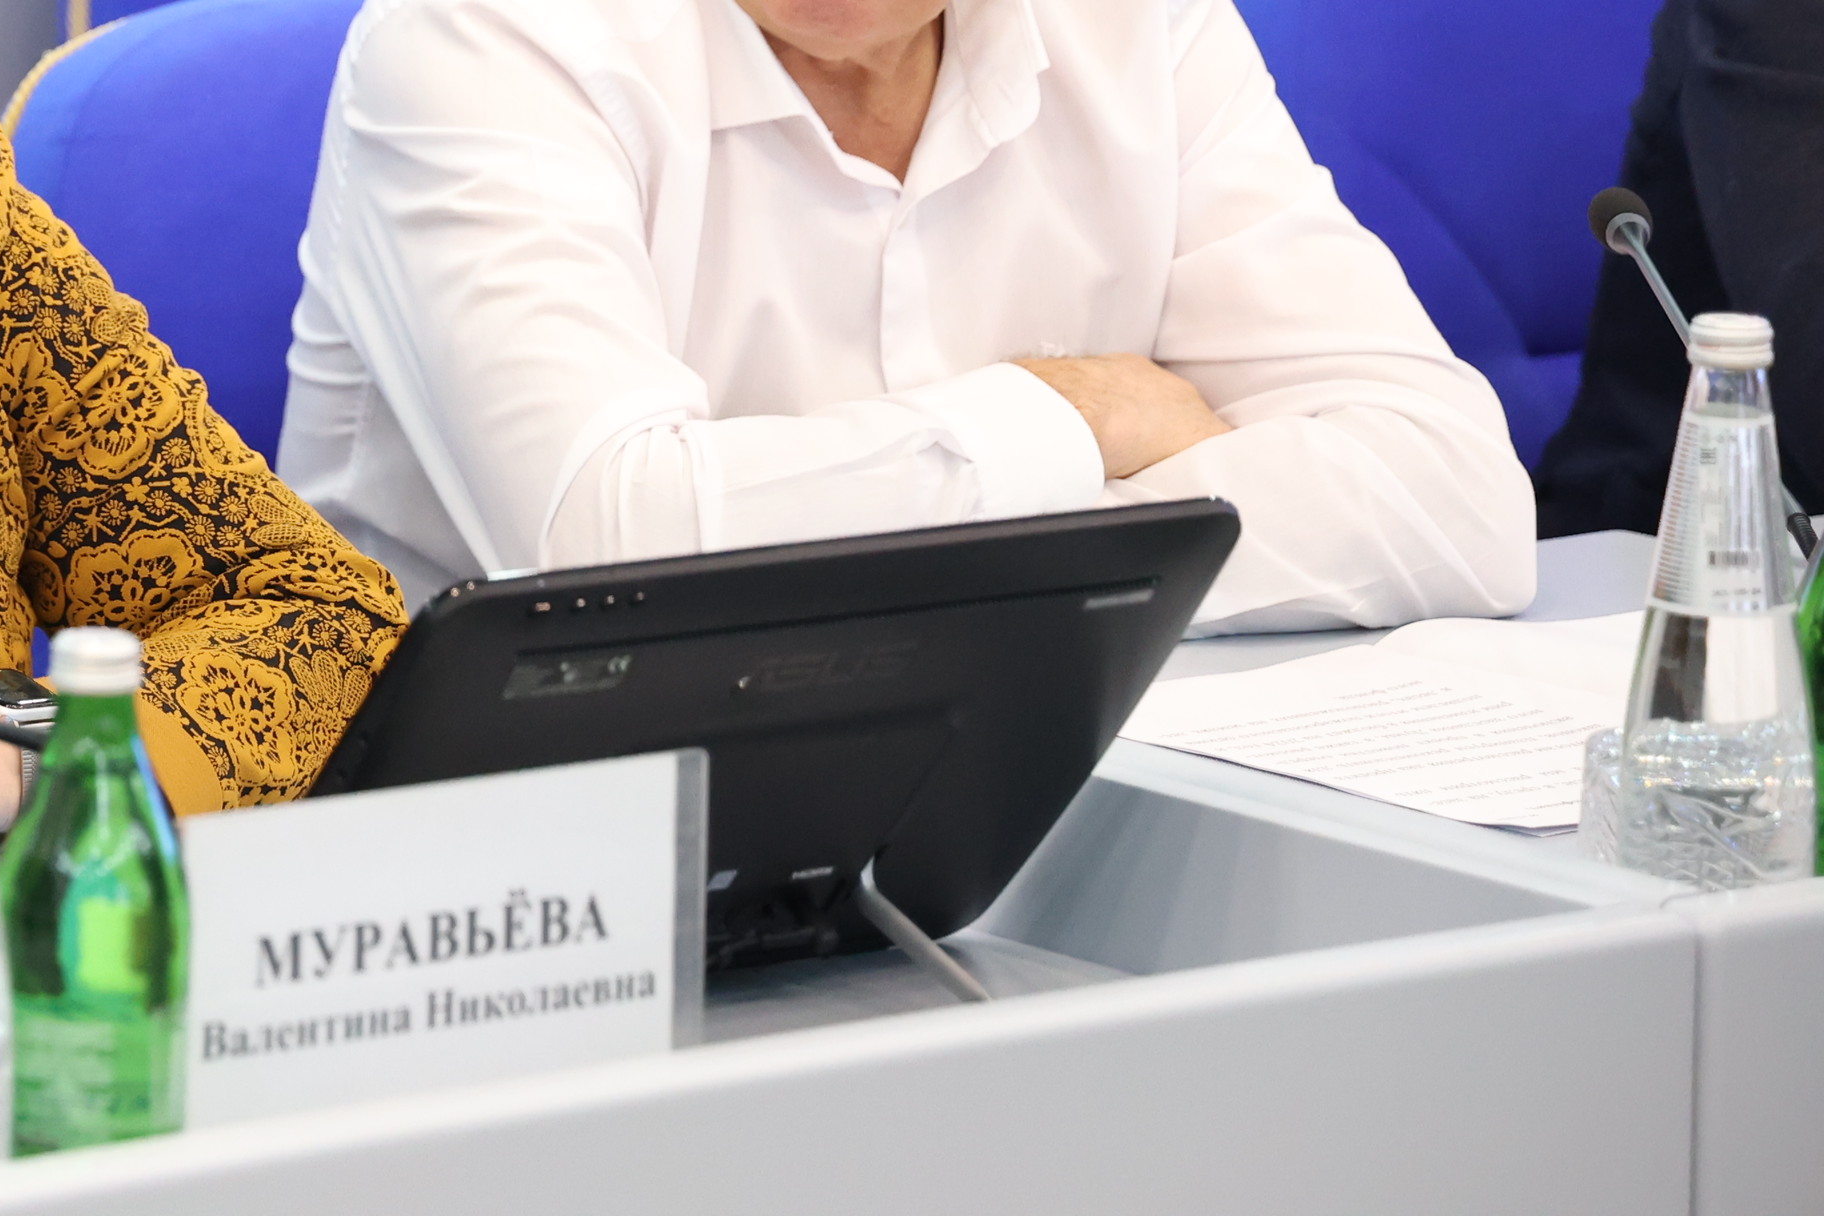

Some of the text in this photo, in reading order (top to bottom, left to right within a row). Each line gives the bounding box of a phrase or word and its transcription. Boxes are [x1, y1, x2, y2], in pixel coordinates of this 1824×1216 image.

[256, 887, 609, 990] МУРАВЬЁВА
[201, 969, 657, 1062] Валентина Николаевна
